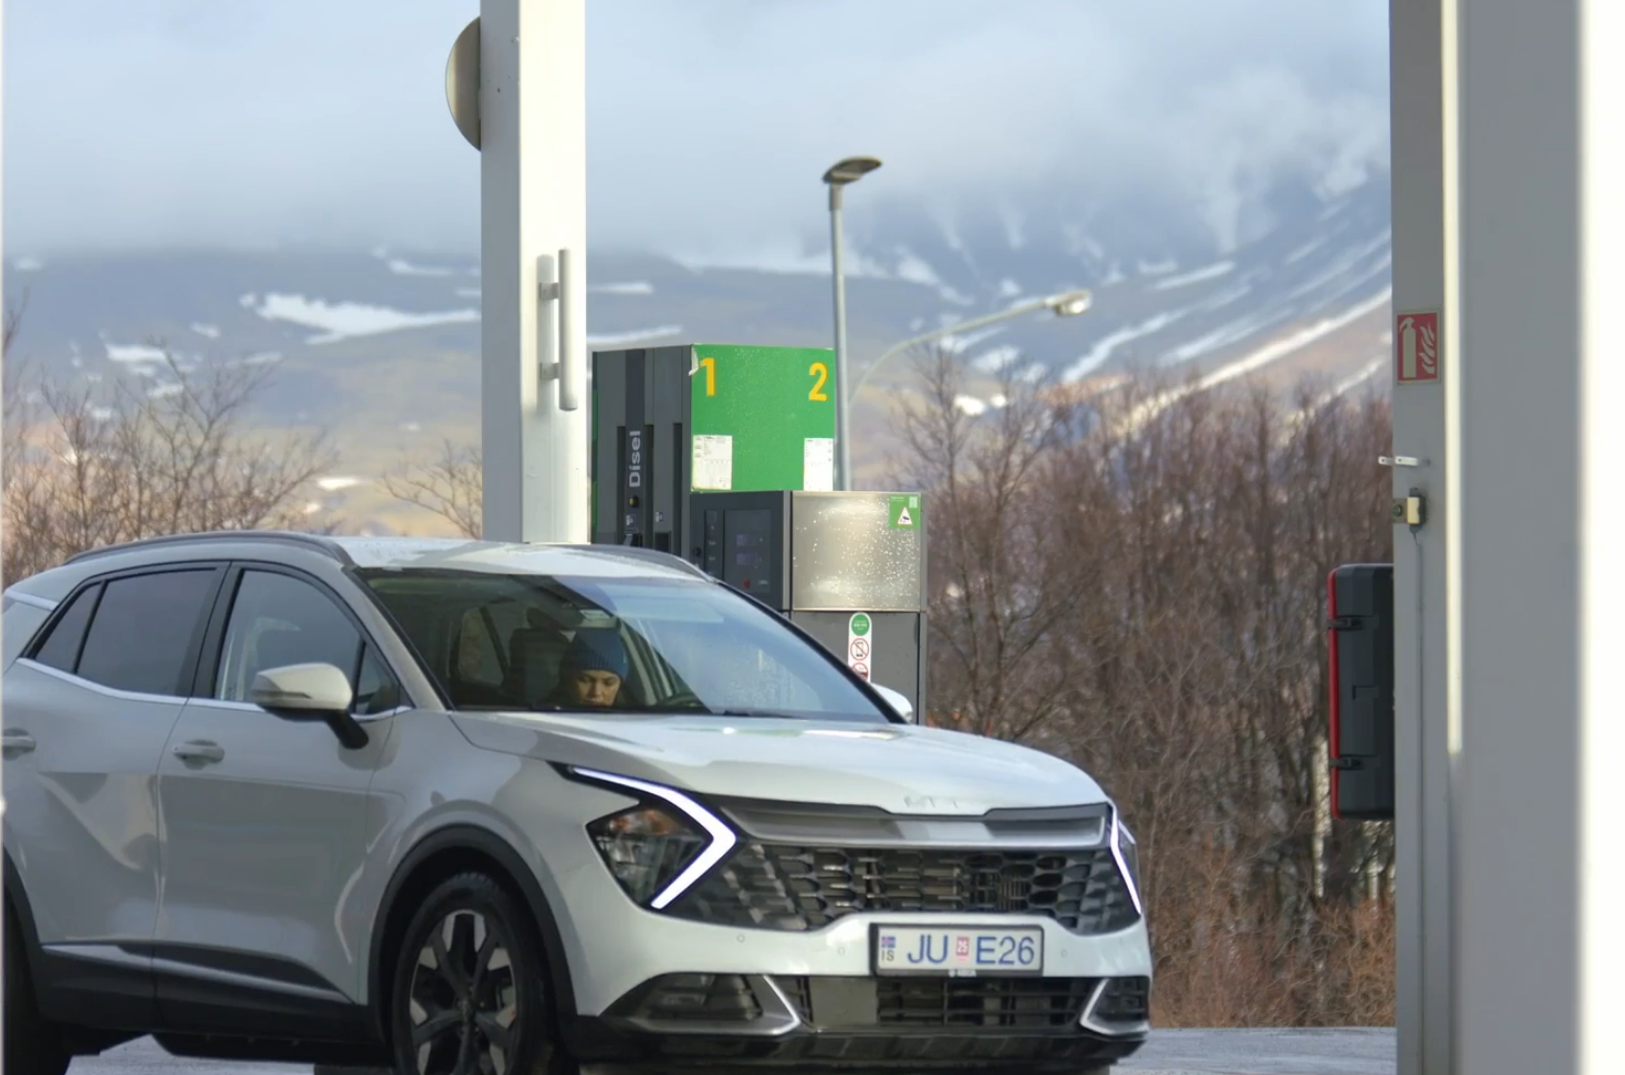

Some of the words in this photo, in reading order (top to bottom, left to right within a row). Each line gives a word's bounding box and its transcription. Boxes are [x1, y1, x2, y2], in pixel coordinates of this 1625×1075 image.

[700, 357, 716, 396] 1
[808, 362, 828, 401] 2
[629, 430, 641, 487] Disel
[881, 951, 895, 961] IS
[907, 934, 949, 963] JU
[976, 936, 1035, 965] E26
